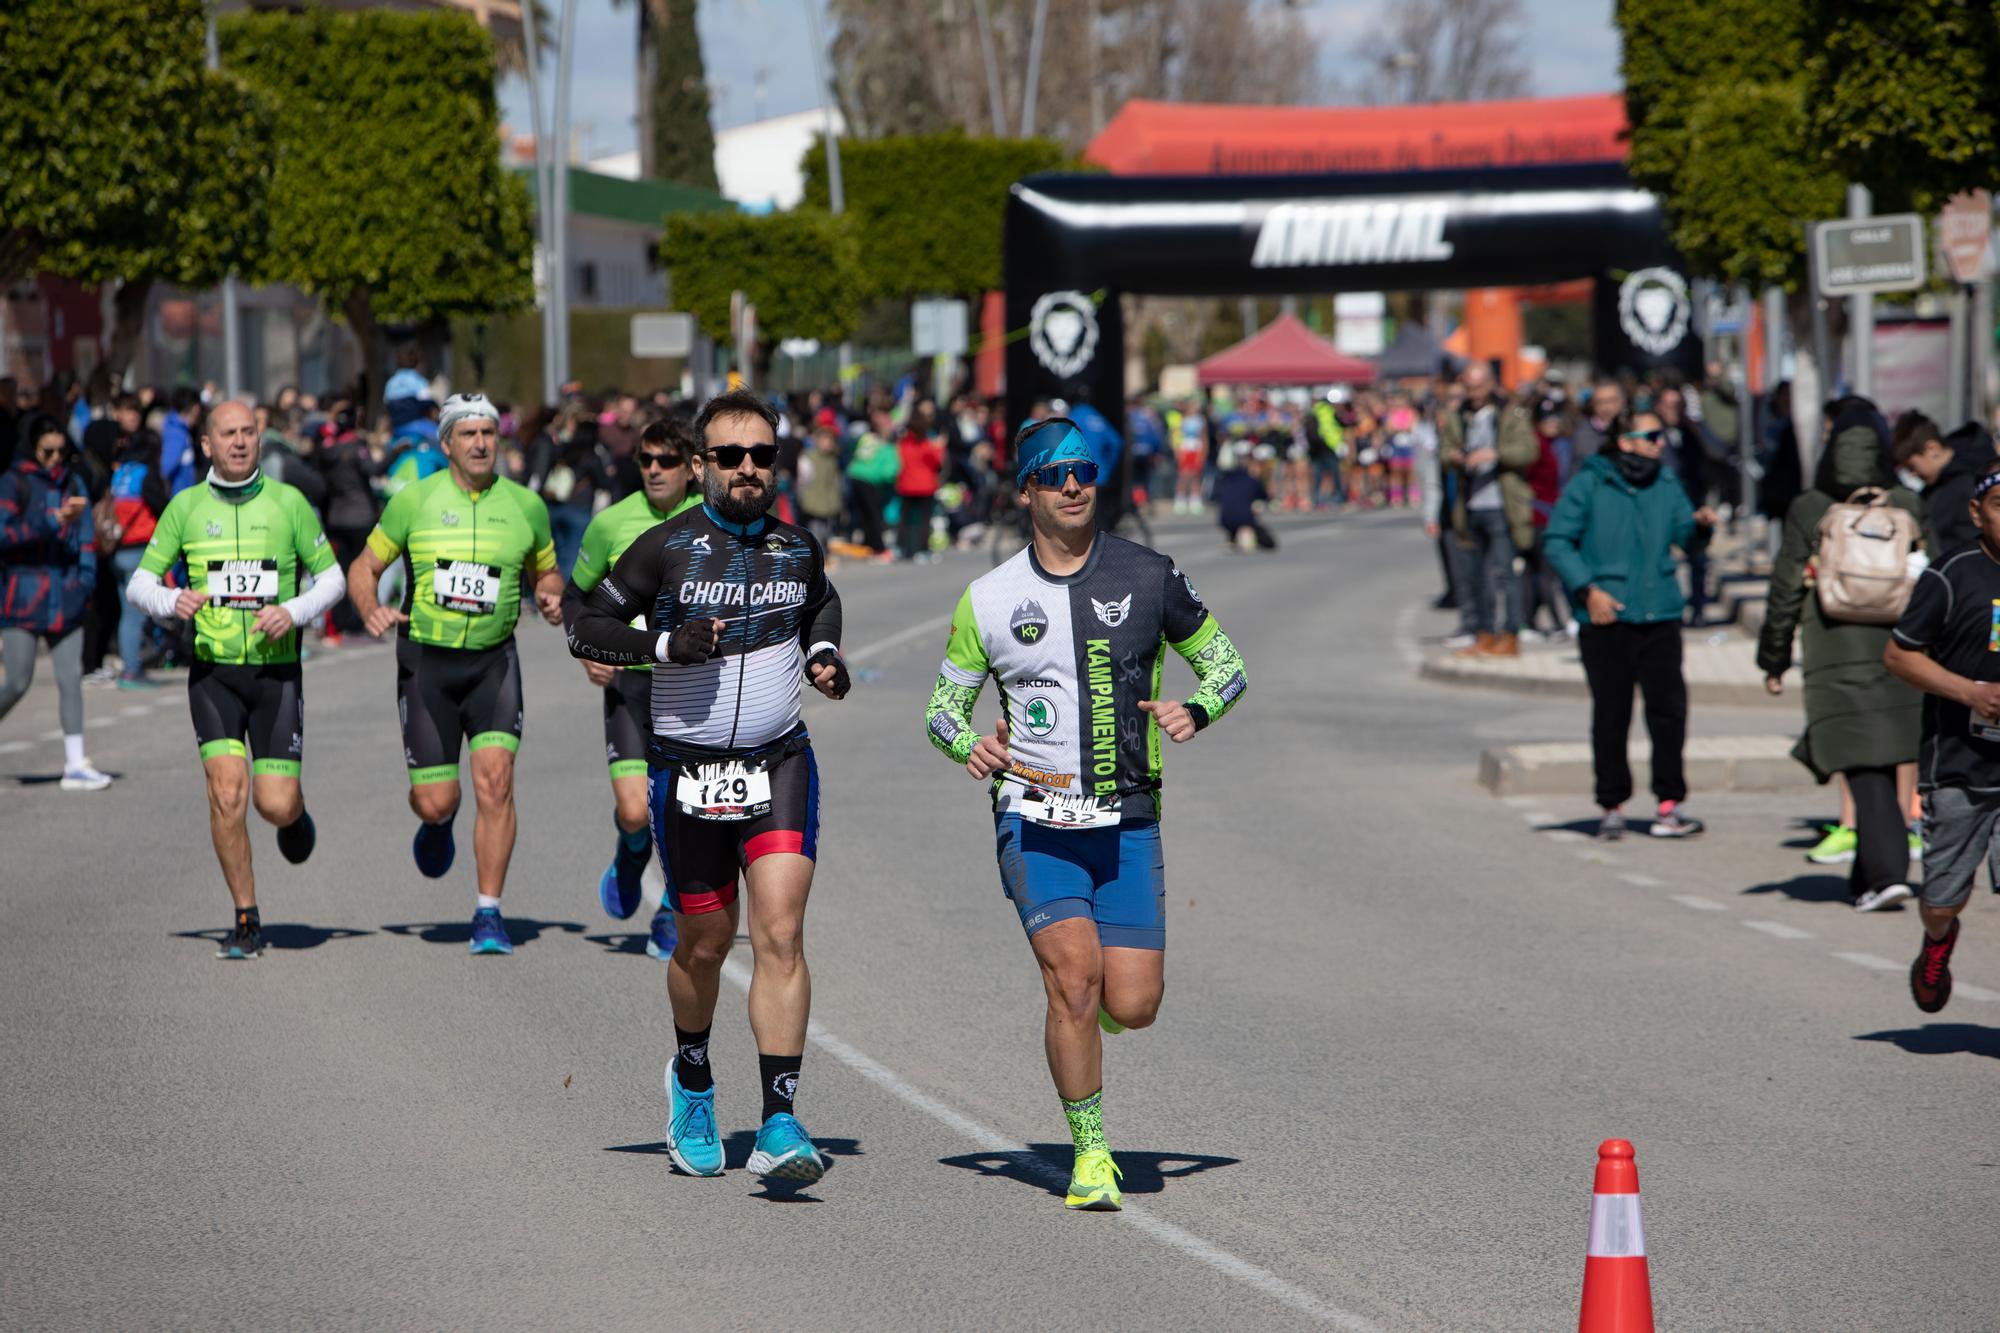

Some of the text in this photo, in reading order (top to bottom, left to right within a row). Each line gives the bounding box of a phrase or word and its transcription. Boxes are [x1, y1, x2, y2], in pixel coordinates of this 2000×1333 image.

[1251, 202, 1454, 268] ANIMAL
[224, 574, 261, 593] 137
[449, 575, 485, 597] 158
[1017, 678, 1062, 689] ŠKODA
[1086, 639, 1117, 776] KAMPAMENTO
[699, 778, 749, 806] 129
[1044, 806, 1097, 824] 132
